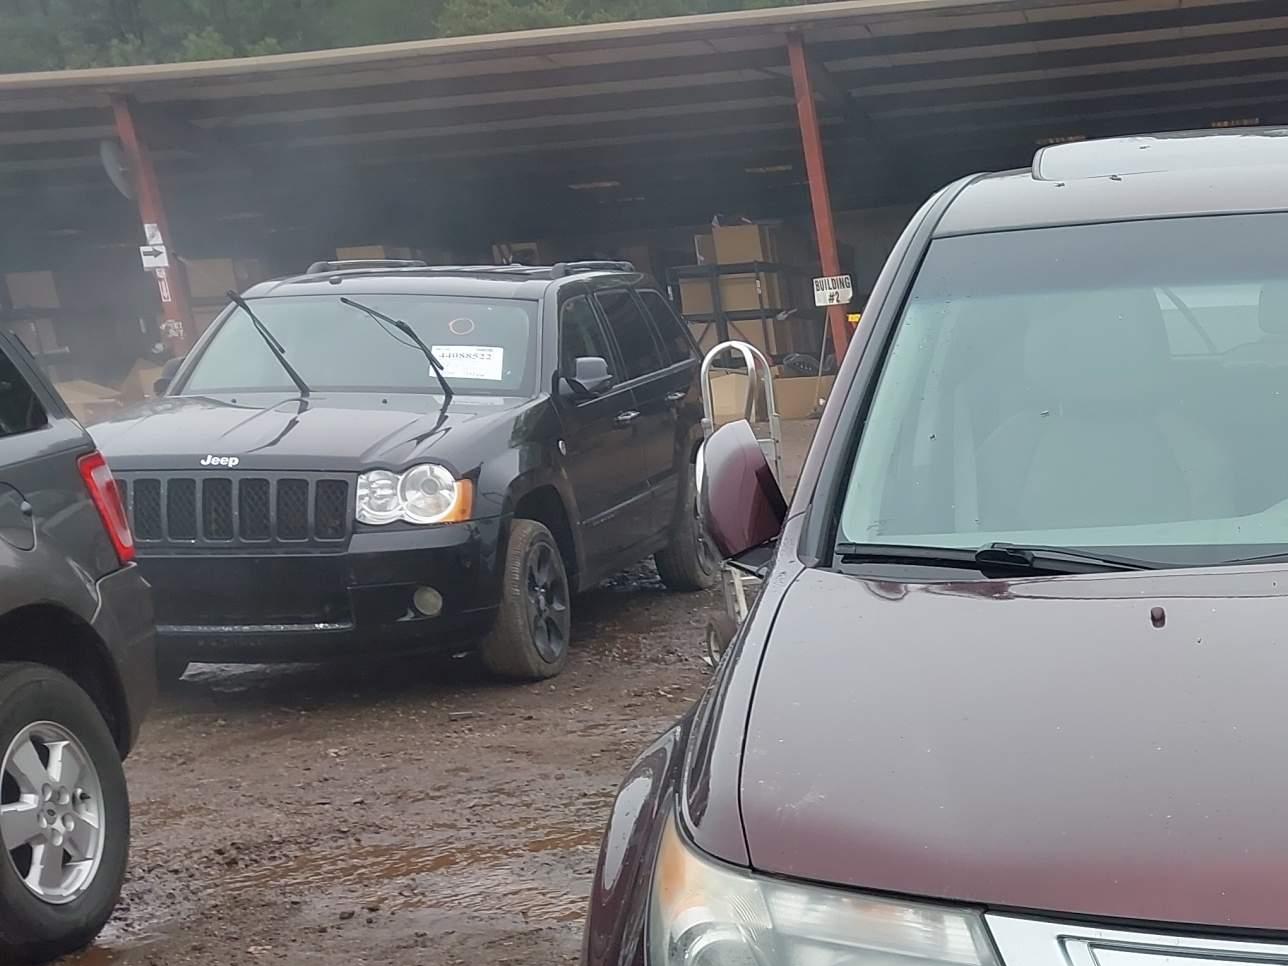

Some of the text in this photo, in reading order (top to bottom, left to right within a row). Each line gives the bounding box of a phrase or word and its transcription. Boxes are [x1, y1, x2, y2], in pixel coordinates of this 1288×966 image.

[815, 277, 851, 291] BUILDING
[828, 291, 840, 303] #2
[200, 454, 240, 468] Jeep
